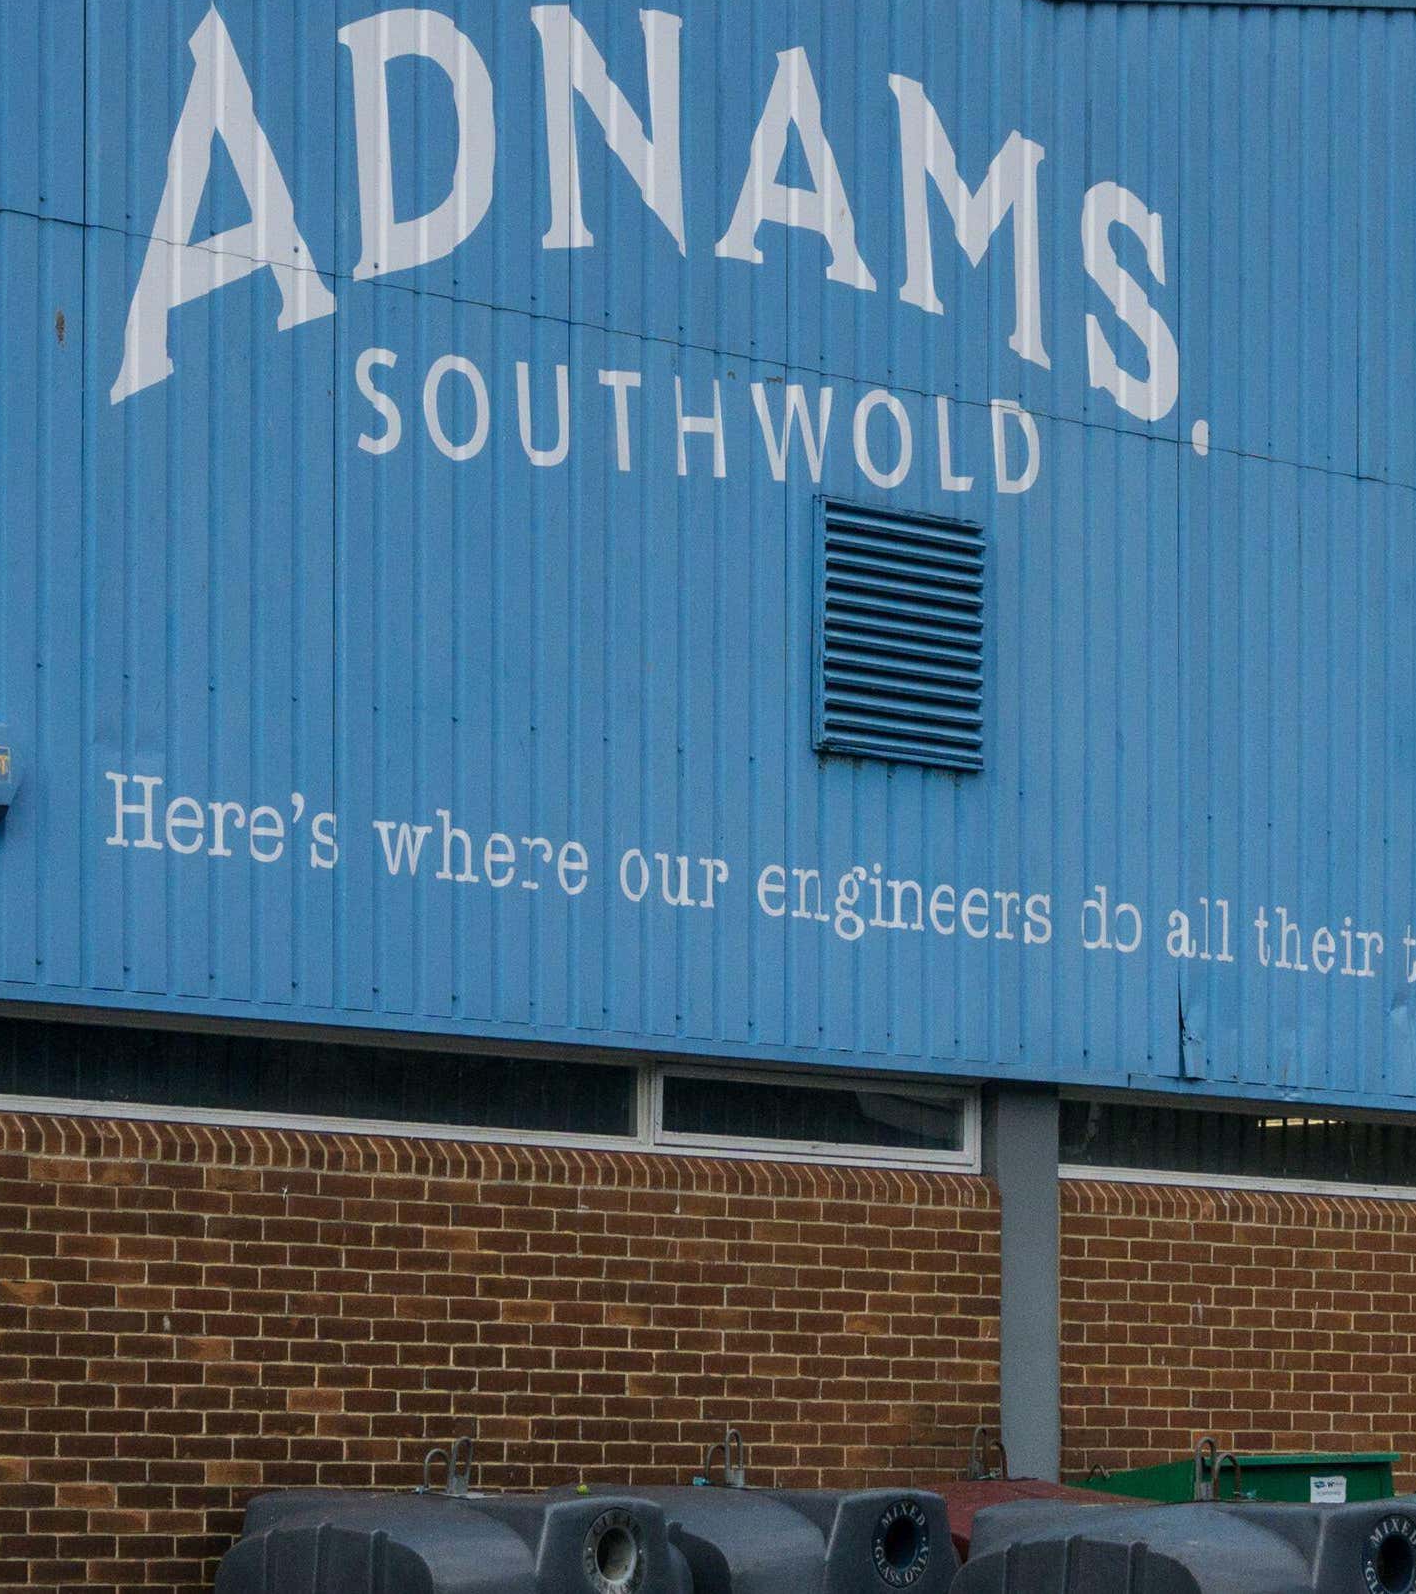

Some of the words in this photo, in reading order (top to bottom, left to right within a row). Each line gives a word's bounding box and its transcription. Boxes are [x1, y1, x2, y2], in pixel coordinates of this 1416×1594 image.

[356, 347, 1042, 495] SOUTHWOLD
[105, 770, 339, 869] Here's
[372, 808, 589, 896] where
[619, 846, 729, 909] our
[757, 862, 1052, 944] engineers
[1081, 885, 1143, 954] do
[1166, 897, 1234, 962] all
[1254, 906, 1384, 977] their
[881, 1503, 926, 1527] MIXED
